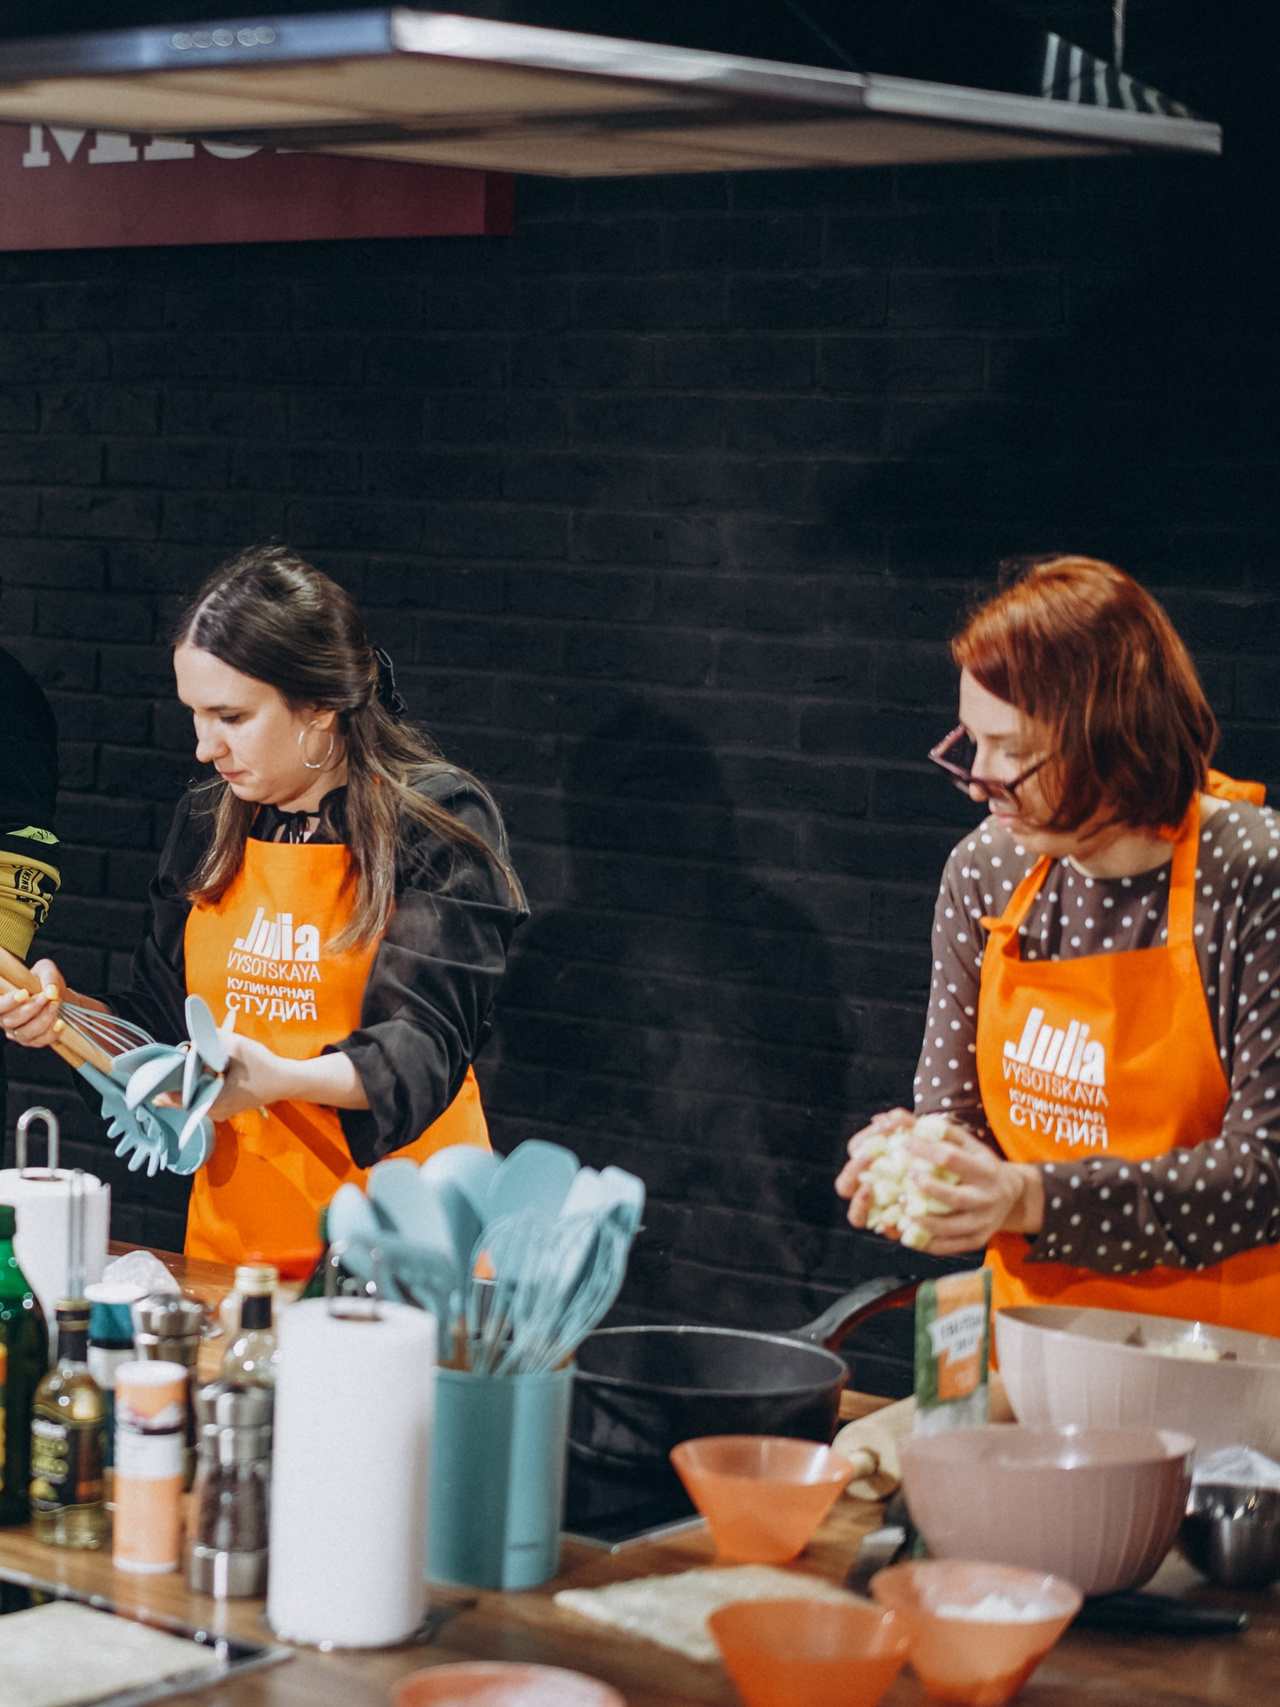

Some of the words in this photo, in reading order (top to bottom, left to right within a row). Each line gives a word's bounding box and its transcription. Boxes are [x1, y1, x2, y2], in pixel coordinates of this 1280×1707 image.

[232, 906, 320, 962] Julia
[226, 950, 322, 983] VYSOTSKAYA
[225, 991, 318, 1023] СТУДИЯ
[226, 976, 316, 1001] КУЛИНАРНАЯ
[1003, 1006, 1106, 1087] Julia
[1002, 1057, 1109, 1108] VYSOTSKAYA
[1009, 1087, 1106, 1125] КУЛИНАРНАЯ
[1009, 1103, 1109, 1150] СТУДИЯ
